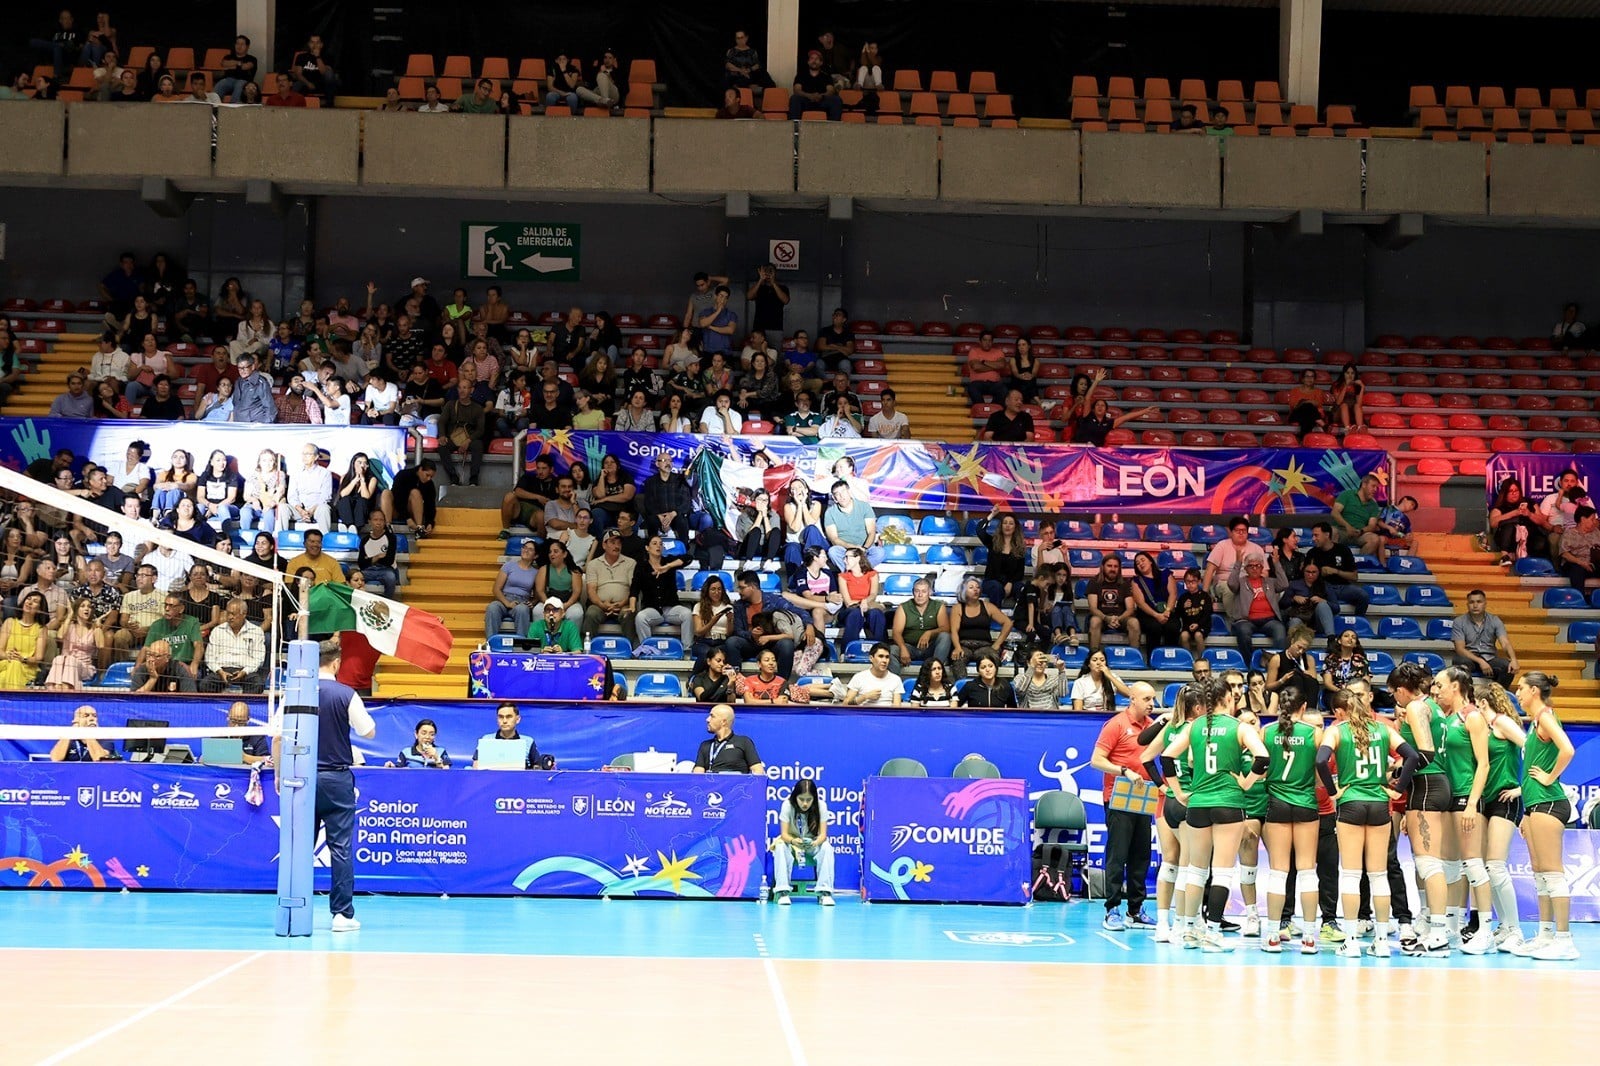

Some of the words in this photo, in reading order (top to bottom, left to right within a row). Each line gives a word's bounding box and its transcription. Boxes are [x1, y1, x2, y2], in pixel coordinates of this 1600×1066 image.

[523, 227, 553, 237] SALIDA
[555, 228, 568, 237] DE
[517, 237, 573, 247] EMERGENCIA
[628, 441, 684, 457] Senior
[1095, 457, 1205, 497] LEÓN
[1206, 742, 1218, 775] 6
[1283, 751, 1295, 781] 7
[1355, 745, 1382, 779] 24
[102, 787, 142, 803] LEÓN
[151, 798, 199, 807] NORCECA
[368, 799, 418, 814] Senior
[495, 798, 525, 810] GTO
[597, 797, 635, 812] LEÓN
[645, 806, 692, 816] NORCECA
[359, 816, 420, 828] NORCECA
[422, 817, 467, 829] Women
[358, 829, 387, 844] Pan
[390, 830, 467, 845] American
[912, 826, 1005, 845] COMUDE
[417, 849, 431, 857] and
[969, 841, 1005, 855] LEÓN
[356, 847, 393, 866] Cup
